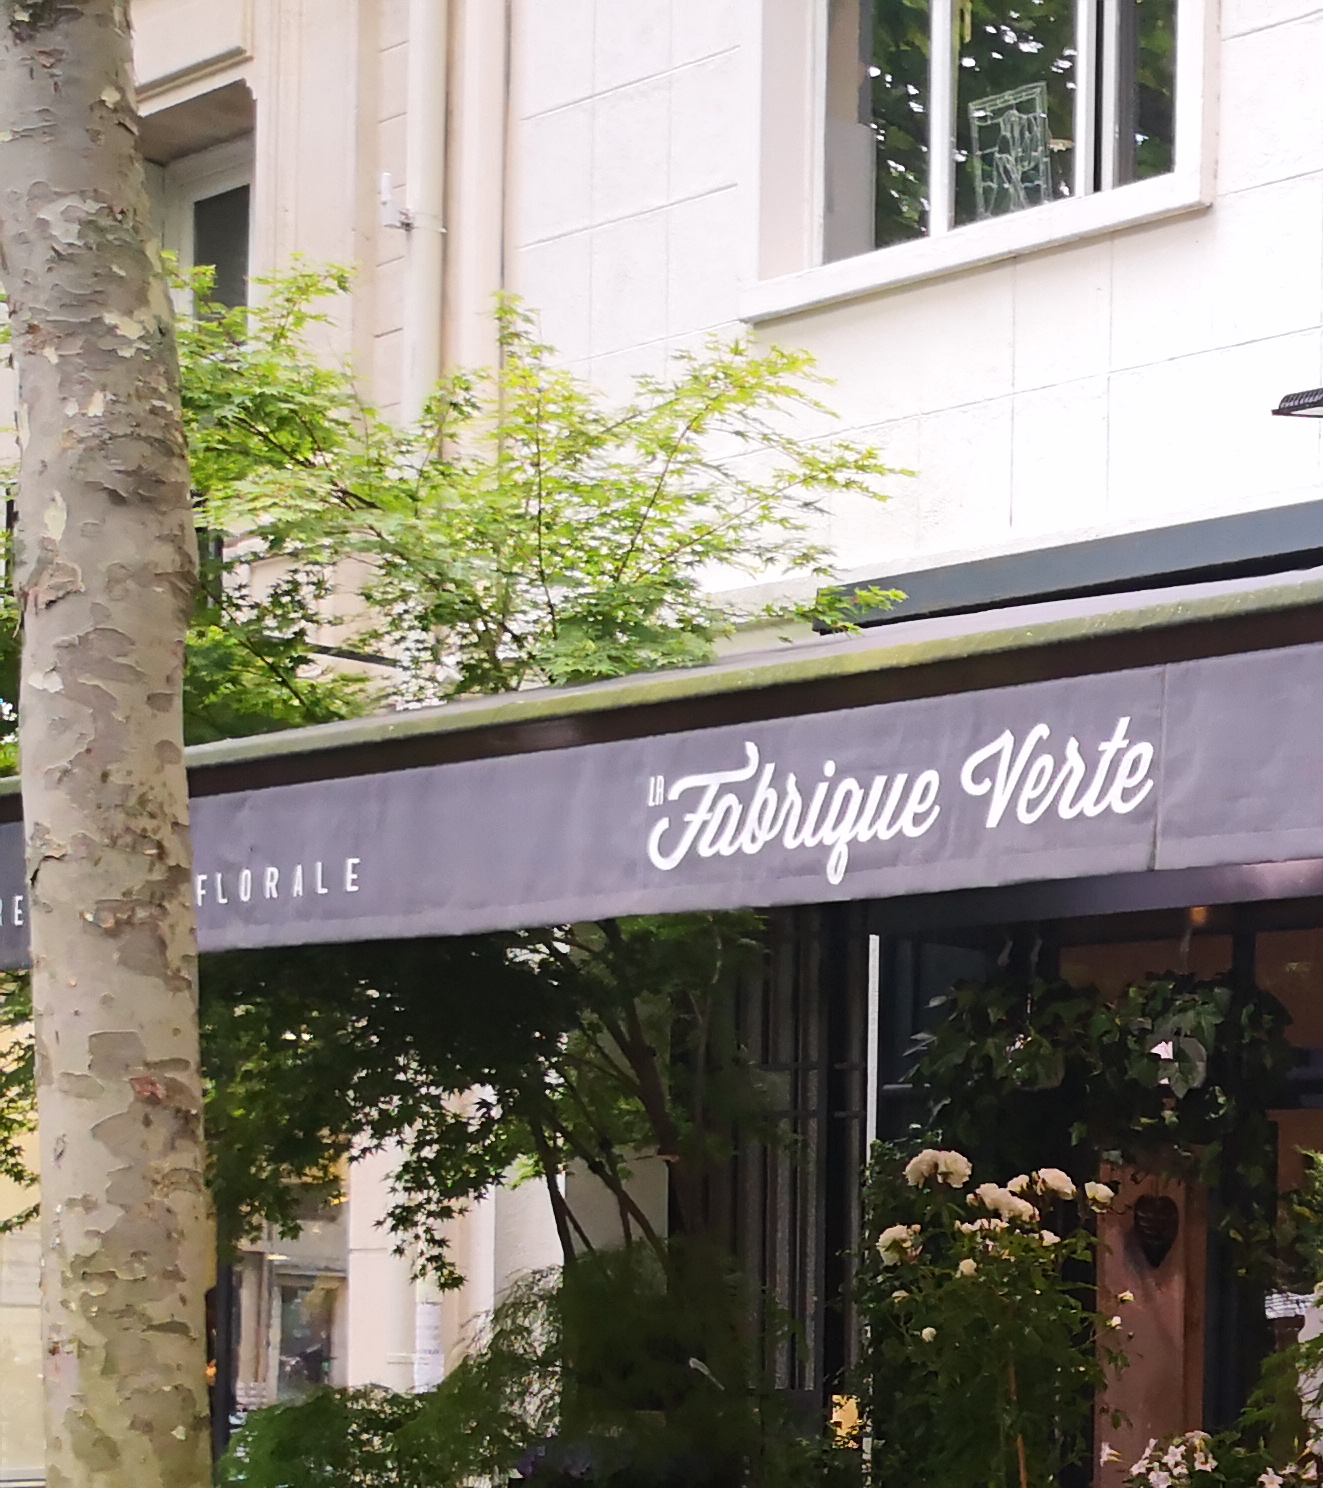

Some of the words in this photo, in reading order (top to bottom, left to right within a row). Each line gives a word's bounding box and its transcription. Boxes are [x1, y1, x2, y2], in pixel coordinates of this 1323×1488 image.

[646, 740, 940, 885] Fabrique
[647, 775, 665, 807] LA
[960, 716, 1154, 829] Verte
[194, 857, 360, 907] FLORALE
